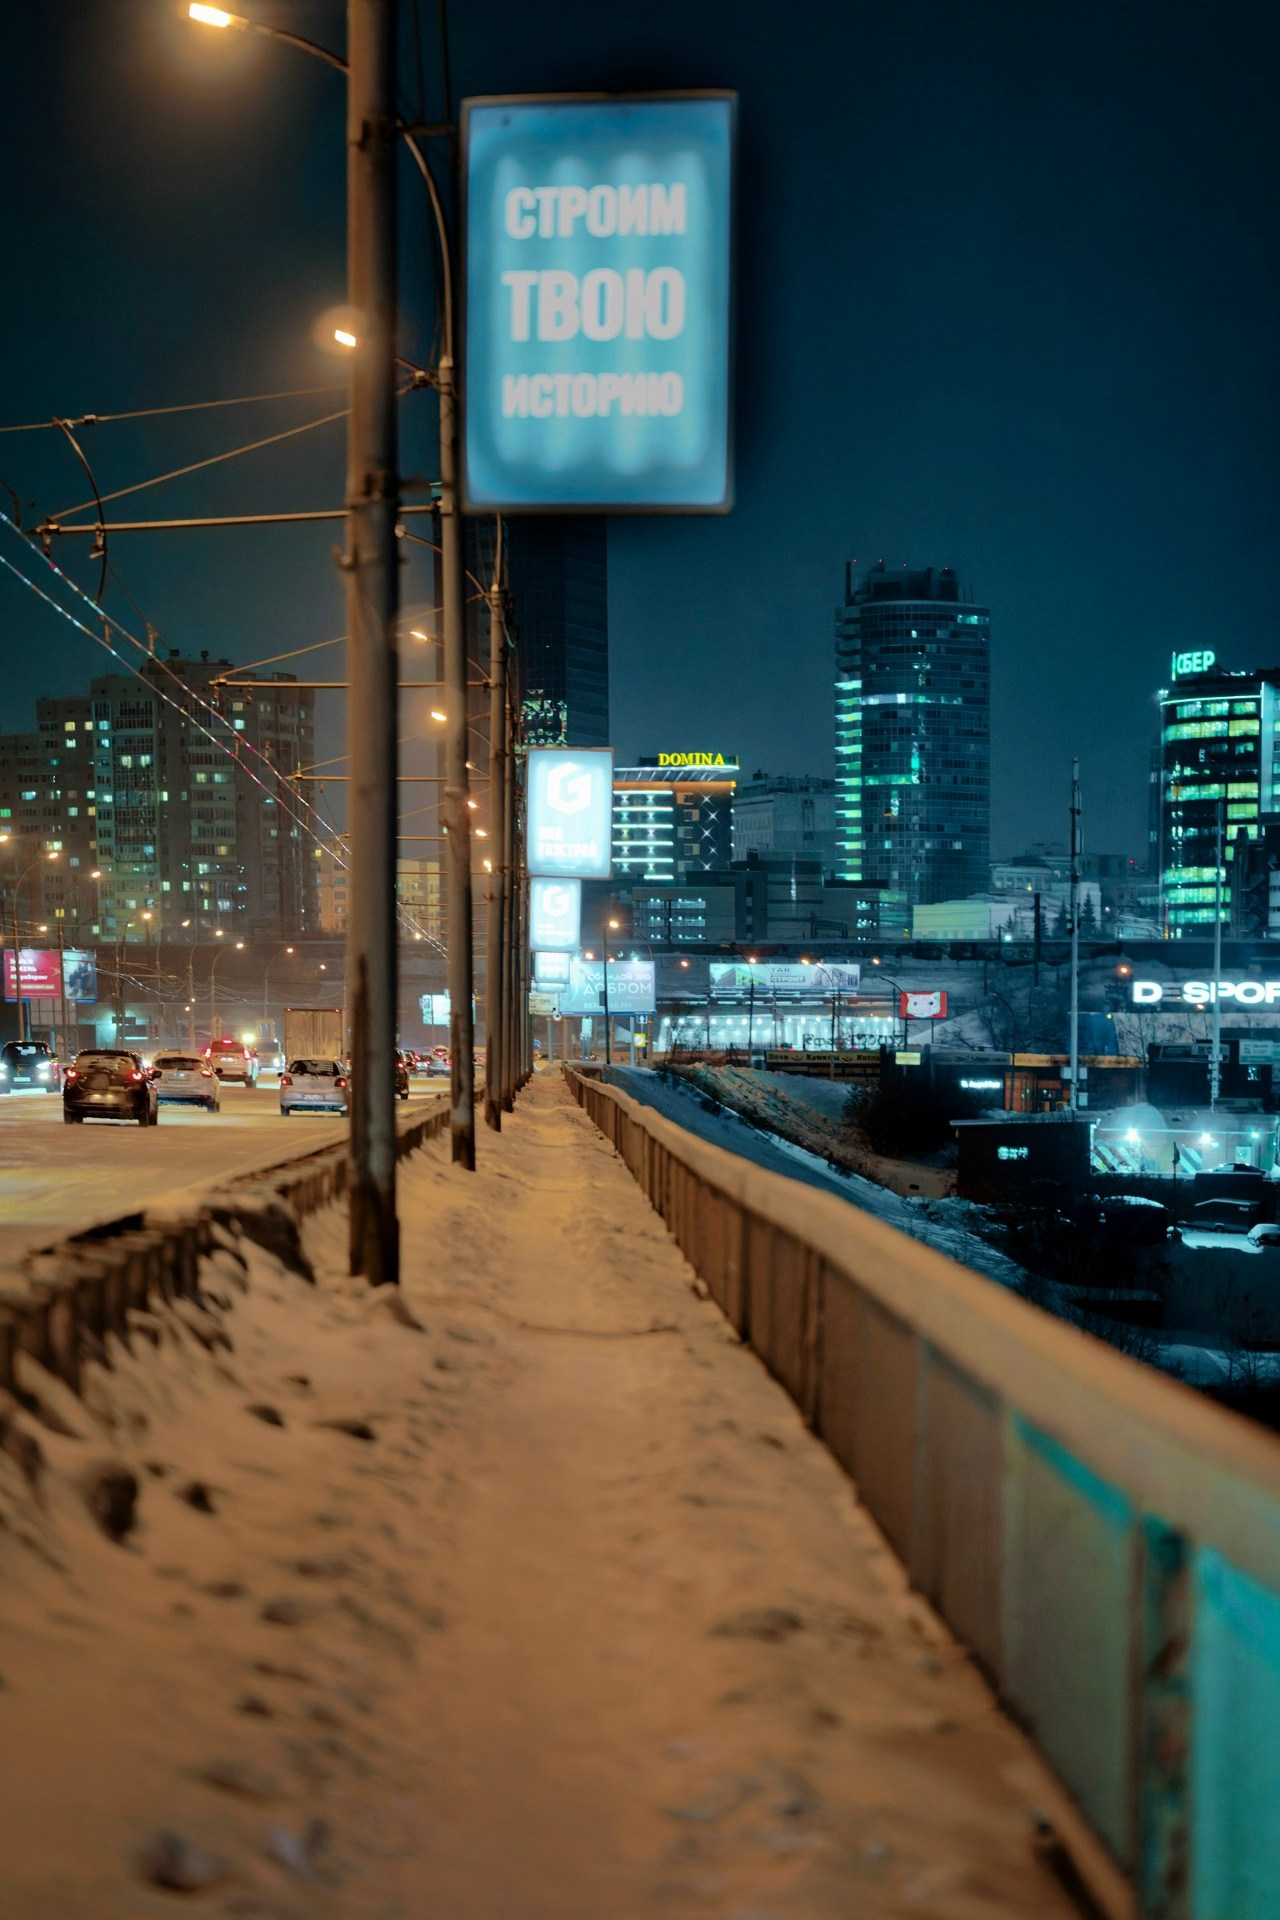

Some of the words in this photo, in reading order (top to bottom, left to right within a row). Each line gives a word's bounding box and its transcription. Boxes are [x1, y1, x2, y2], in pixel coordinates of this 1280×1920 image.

[506, 183, 686, 238] СТРОИМ
[501, 266, 686, 342] ТВОЮ
[502, 371, 684, 418] ИСТОРИЮ
[1176, 650, 1216, 675] СБЕР
[657, 752, 725, 766] DOMINA
[584, 982, 652, 995] ДОБРОМ
